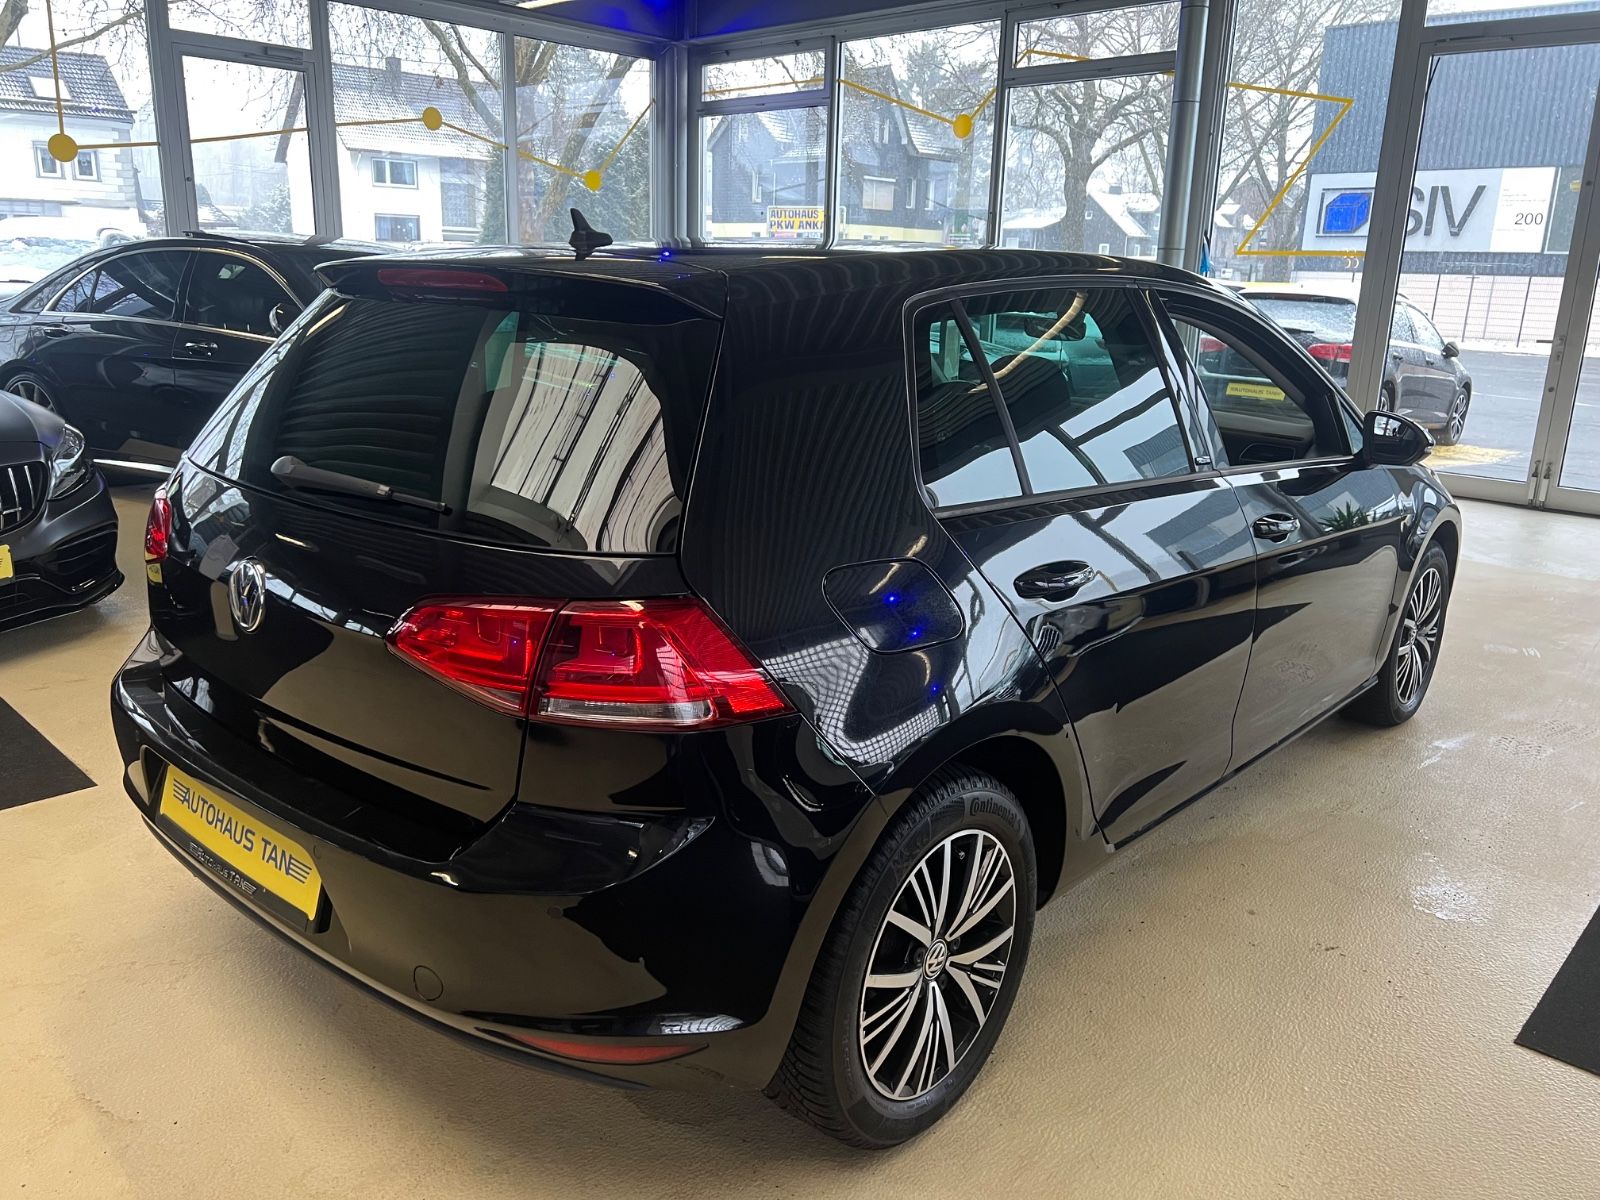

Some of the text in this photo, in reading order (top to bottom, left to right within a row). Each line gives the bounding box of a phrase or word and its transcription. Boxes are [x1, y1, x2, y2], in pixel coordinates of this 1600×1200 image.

[770, 209, 819, 219] AUTOHAUS
[1514, 212, 1544, 225] 200
[770, 220, 795, 230] PKW
[182, 787, 293, 876] AUTOHAUS TAN
